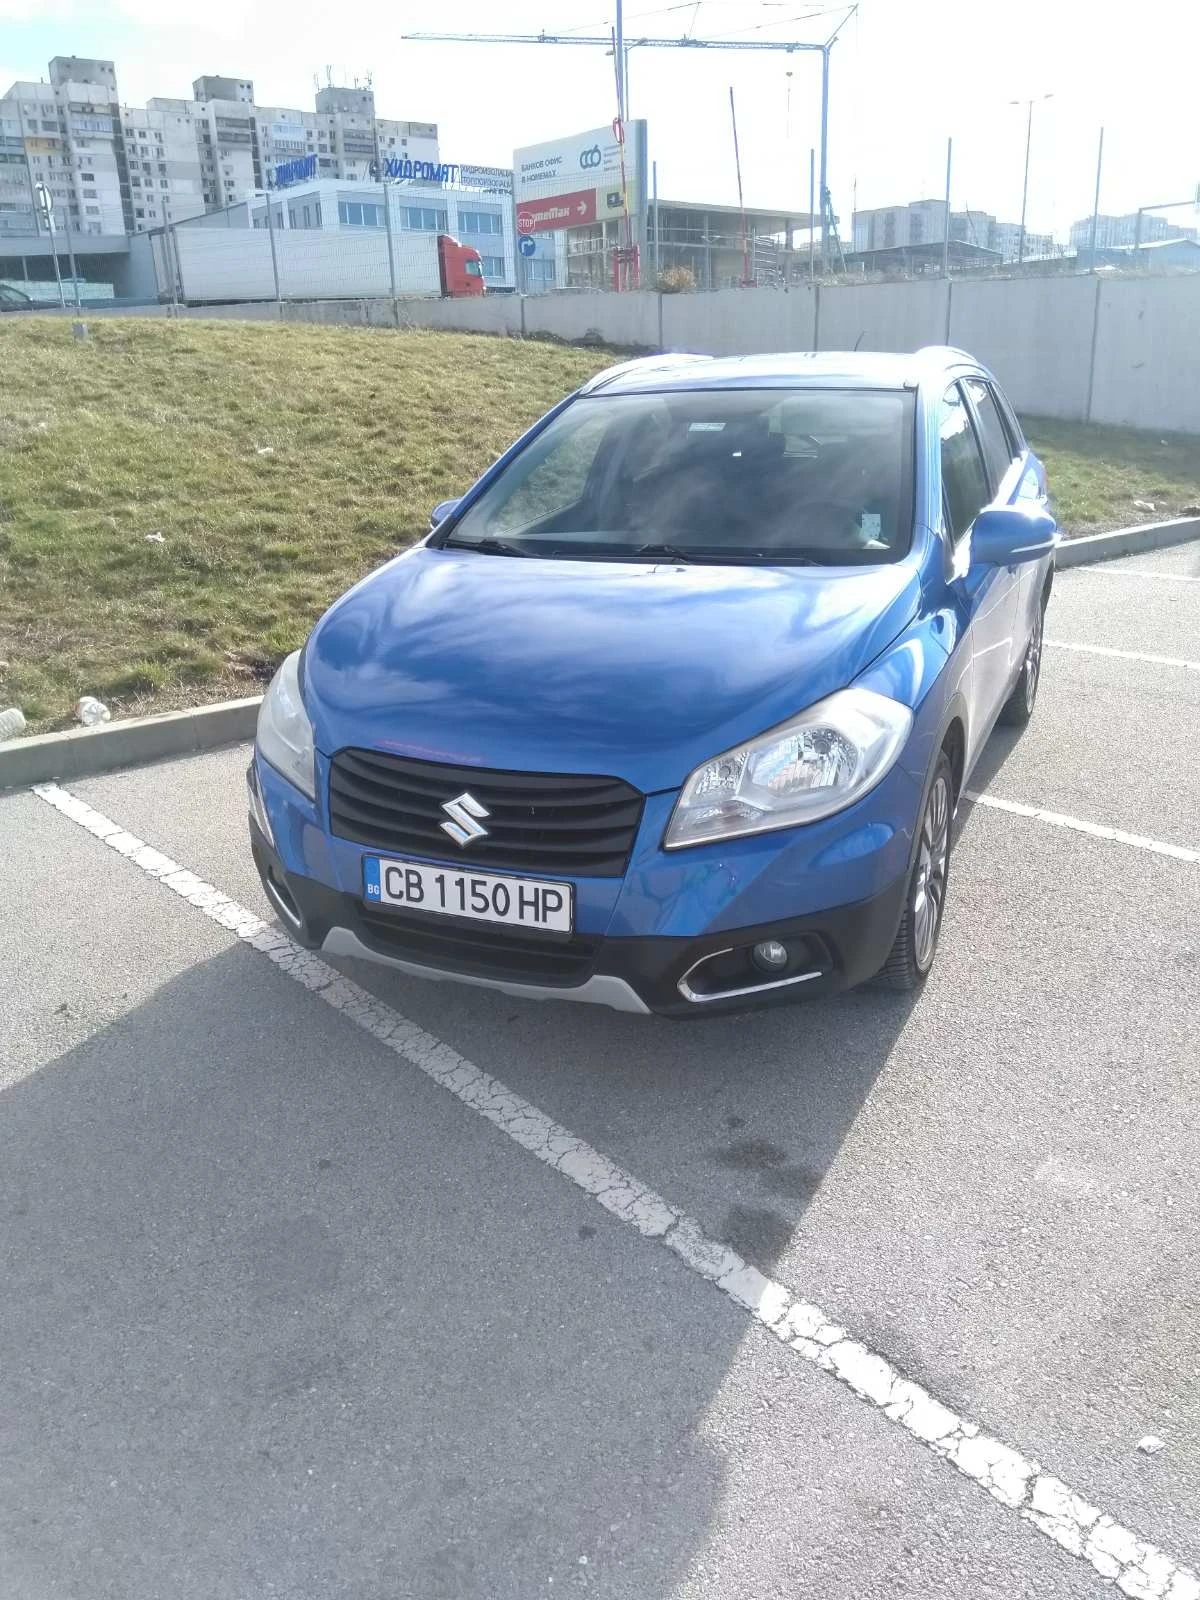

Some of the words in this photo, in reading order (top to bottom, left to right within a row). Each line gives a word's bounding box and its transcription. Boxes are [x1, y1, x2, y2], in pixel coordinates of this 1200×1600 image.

[519, 218, 534, 228] STOP
[367, 883, 380, 895] BG
[385, 866, 425, 902] CB
[434, 874, 511, 917] 1150
[518, 885, 563, 923] HP
